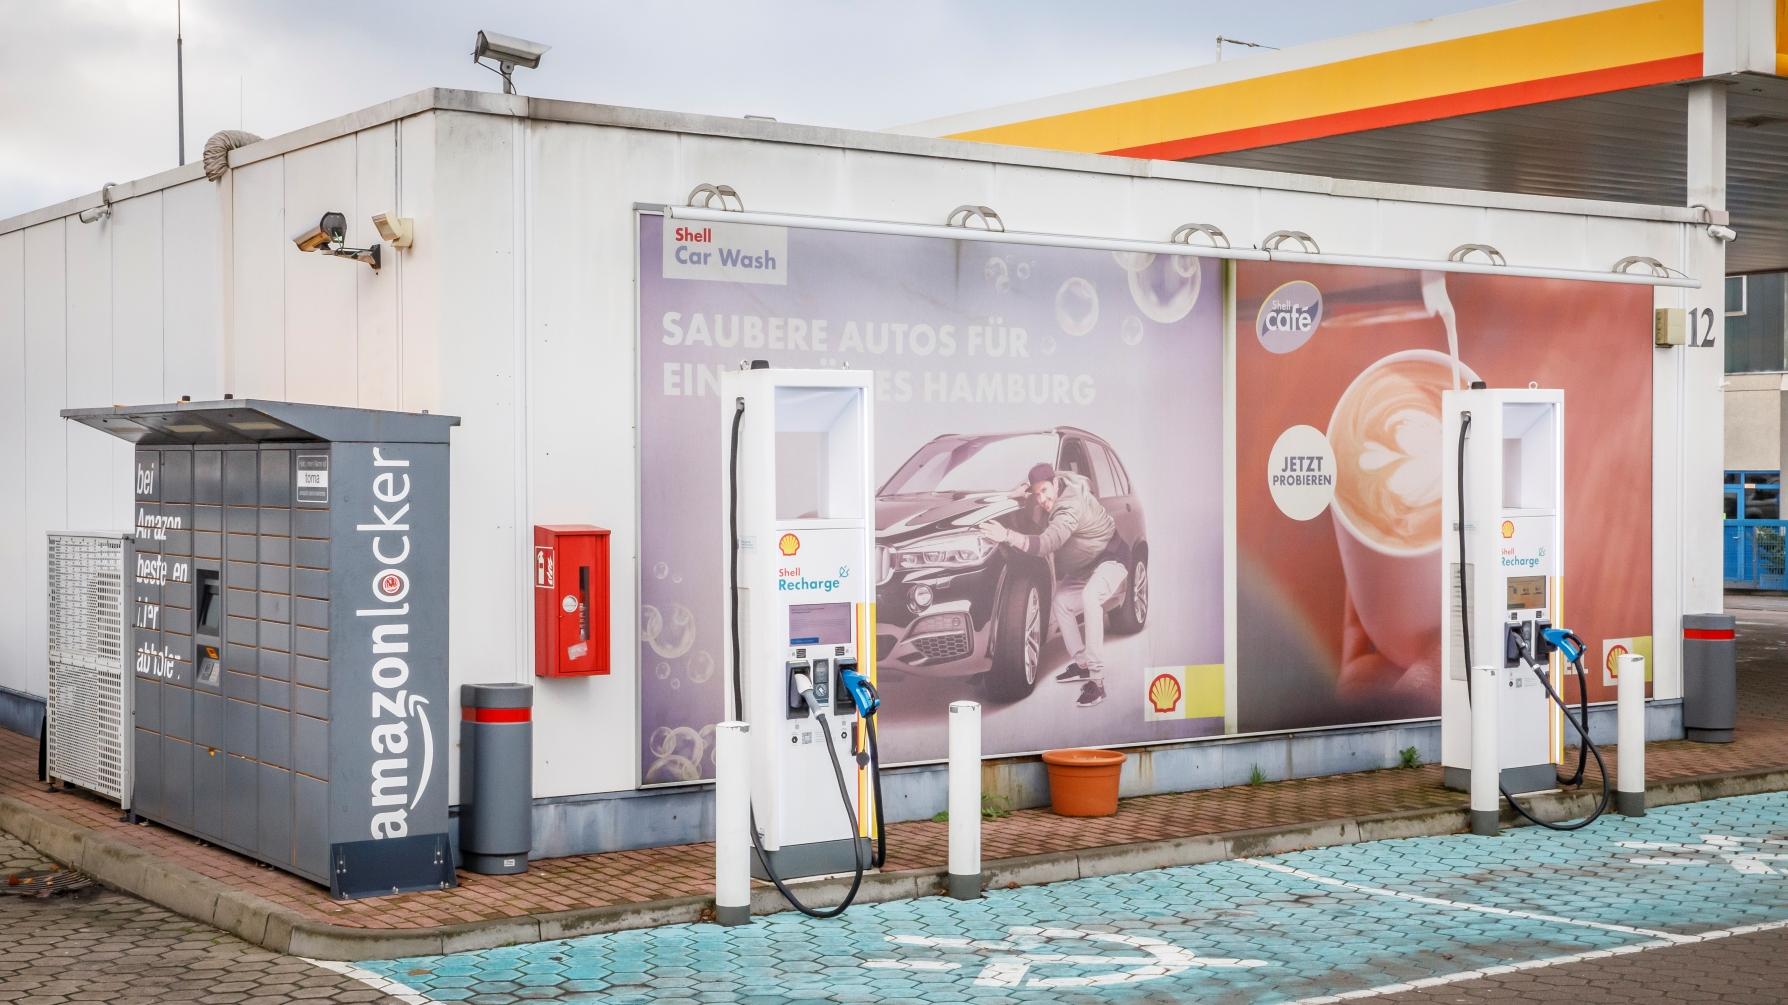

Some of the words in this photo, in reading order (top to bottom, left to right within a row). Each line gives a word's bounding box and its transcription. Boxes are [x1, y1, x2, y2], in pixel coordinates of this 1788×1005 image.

[674, 227, 712, 243] Shell
[674, 246, 711, 267] Car
[718, 247, 776, 271] Wash
[1265, 303, 1312, 332] café
[1271, 300, 1291, 311] Shell
[661, 311, 828, 352] SAUBERE
[839, 319, 957, 357] AUTOS
[968, 317, 1030, 358] FÜR
[1688, 307, 1716, 348] 12
[663, 361, 725, 398] EIN
[923, 370, 1096, 406] HAMBURG
[1281, 456, 1324, 473] JETZT
[136, 463, 154, 495] bei
[1272, 475, 1332, 486] PROBIEREN
[136, 553, 188, 586] besteen
[778, 567, 801, 577] Shell
[778, 577, 840, 592] Recharge
[136, 641, 181, 680] abhole
